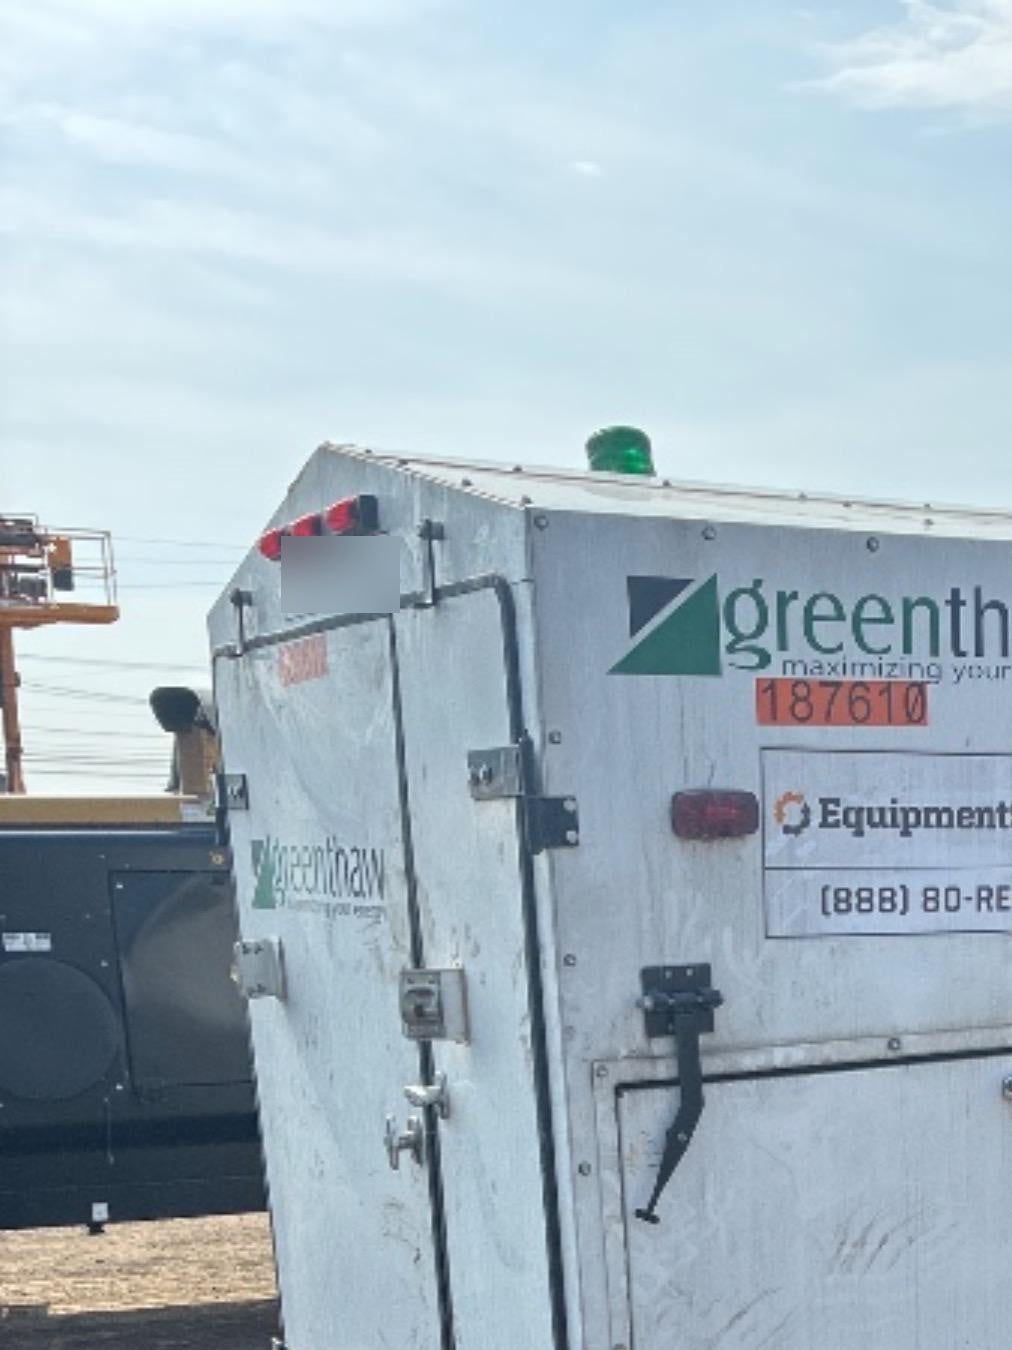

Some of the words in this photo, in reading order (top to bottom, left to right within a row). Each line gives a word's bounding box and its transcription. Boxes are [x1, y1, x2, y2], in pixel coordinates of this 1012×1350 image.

[782, 655, 943, 685] maximizing
[953, 664, 1012, 685] your
[760, 679, 926, 725] 187610
[820, 884, 911, 916] (888)
